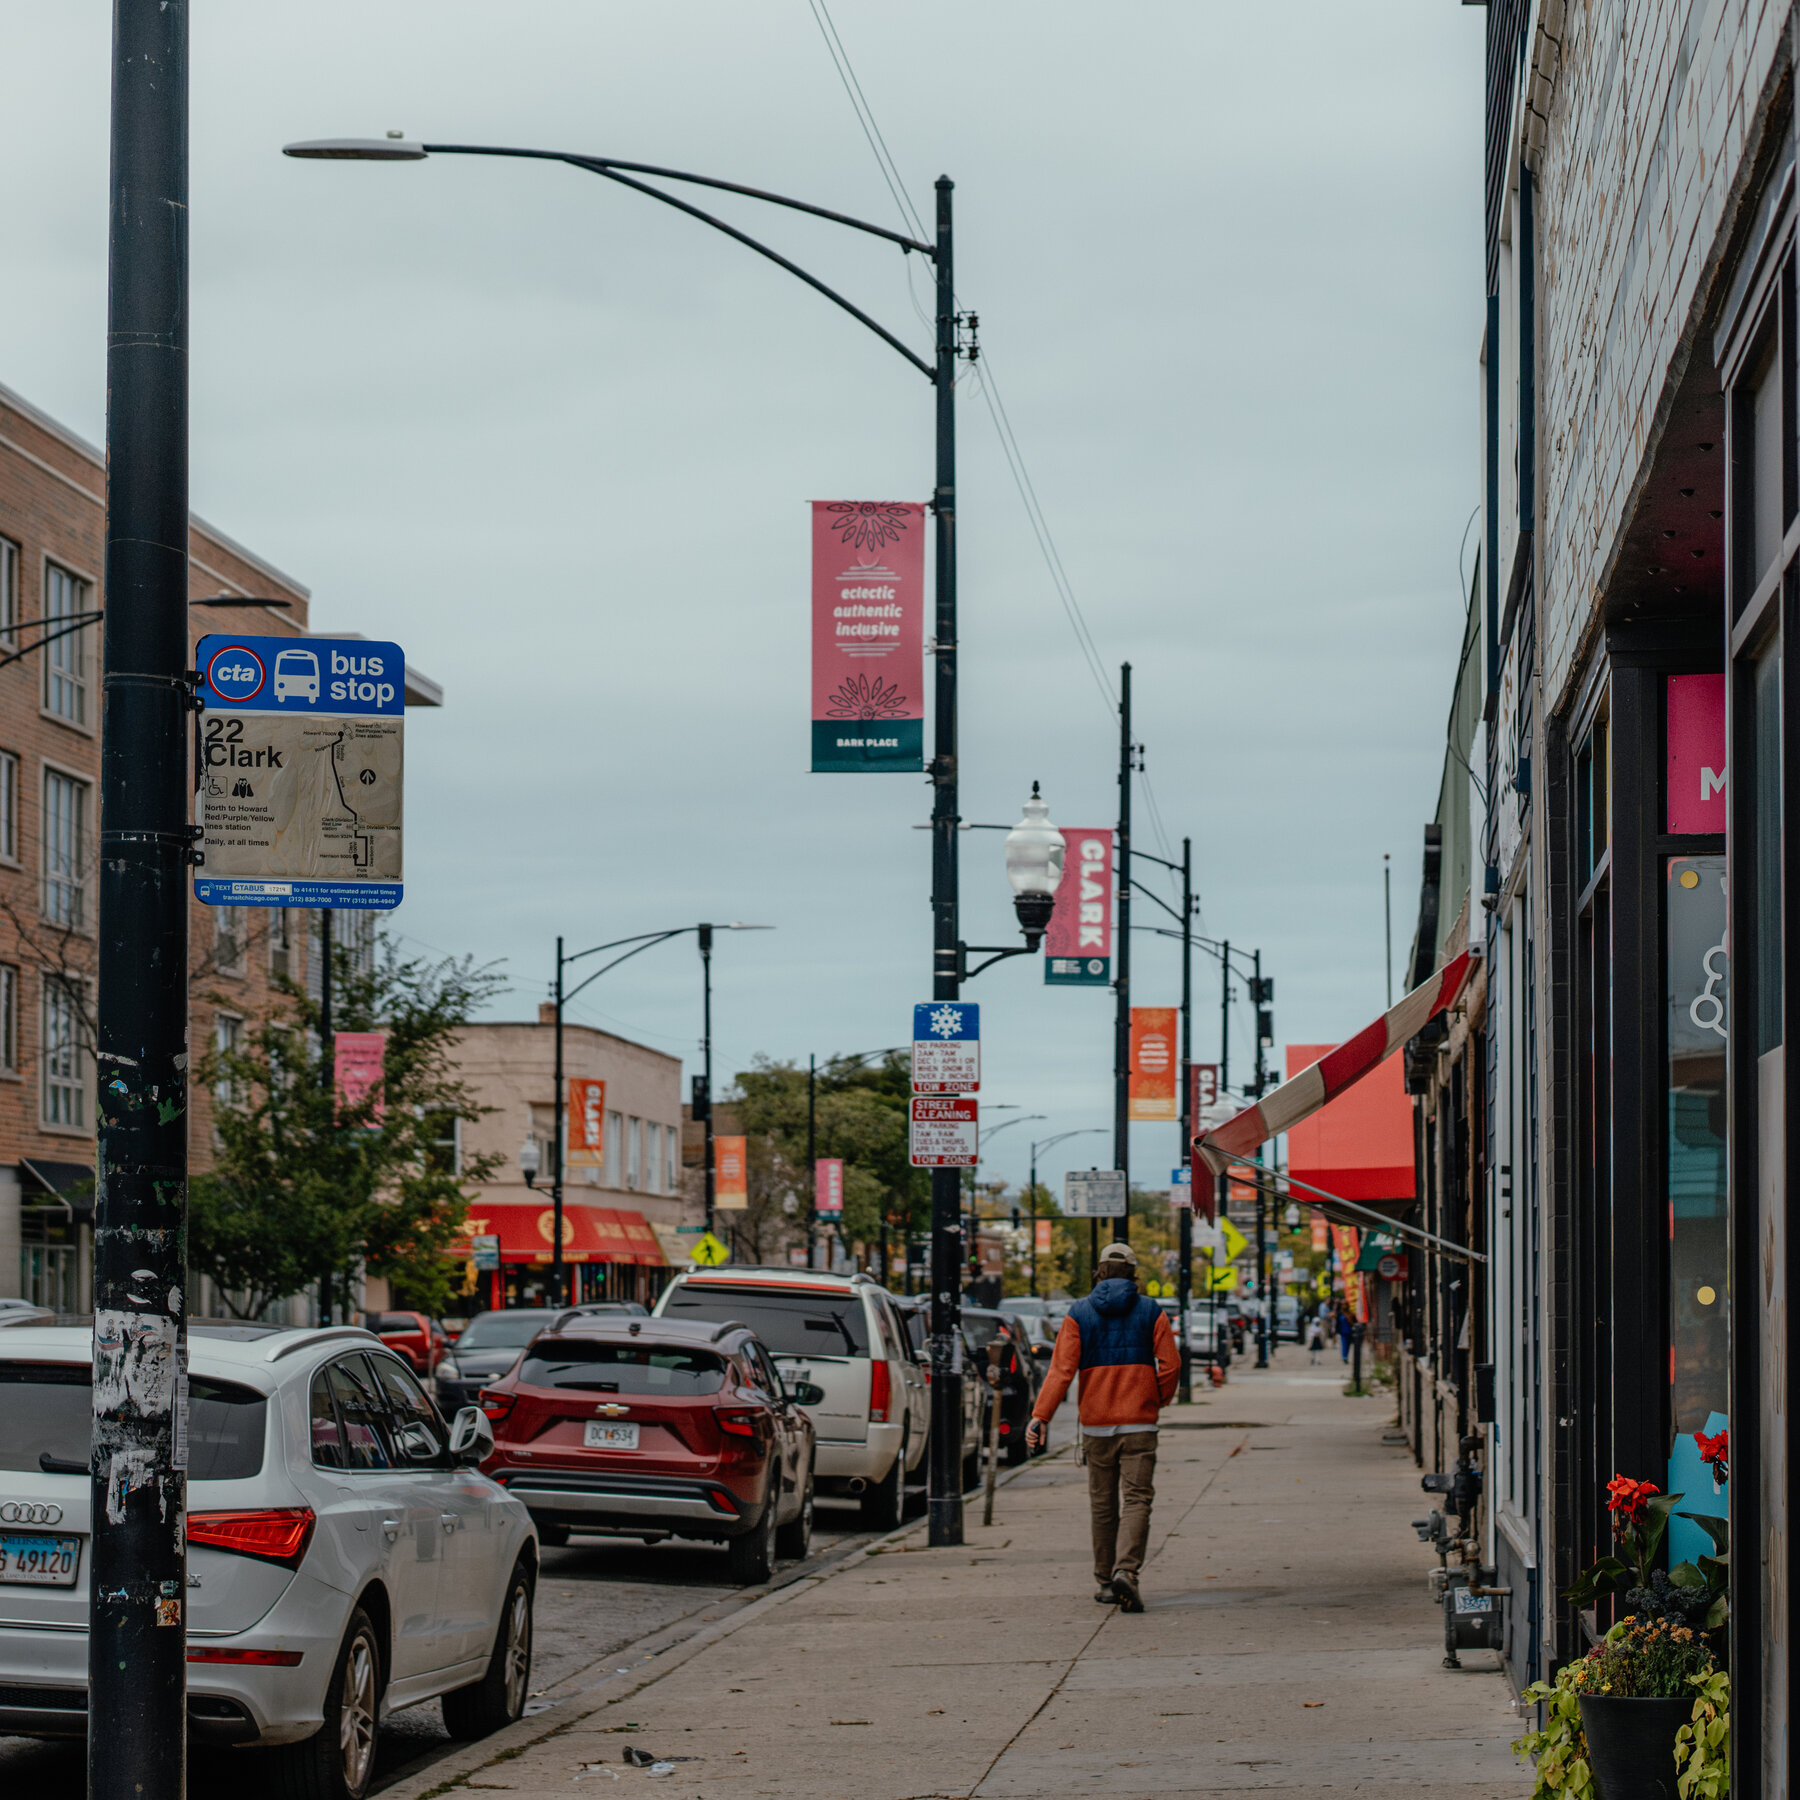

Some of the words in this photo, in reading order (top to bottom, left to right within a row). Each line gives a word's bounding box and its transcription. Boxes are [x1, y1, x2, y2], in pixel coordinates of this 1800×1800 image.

[841, 585, 896, 600] eclectic
[833, 602, 903, 618] authentic
[836, 622, 900, 636] inclusive
[332, 650, 384, 675] bus
[218, 664, 256, 682] cta
[330, 679, 394, 707] stop
[206, 718, 244, 742] 22
[836, 738, 864, 748] BARK
[866, 738, 898, 748] PLACE
[206, 743, 283, 768] Clark
[205, 814, 275, 823] Red/Purple/Yellow
[205, 838, 226, 846] Daily,
[1079, 839, 1105, 948] CLARK
[918, 1082, 939, 1091] TOW
[945, 1082, 974, 1091] ZONE
[916, 1100, 955, 1110] STREET
[585, 1084, 602, 1146] CLARK
[915, 1110, 971, 1120] CLEANING
[916, 1155, 938, 1164] TOW
[943, 1155, 972, 1164] ZONE
[17, 1550, 72, 1574] 49120
